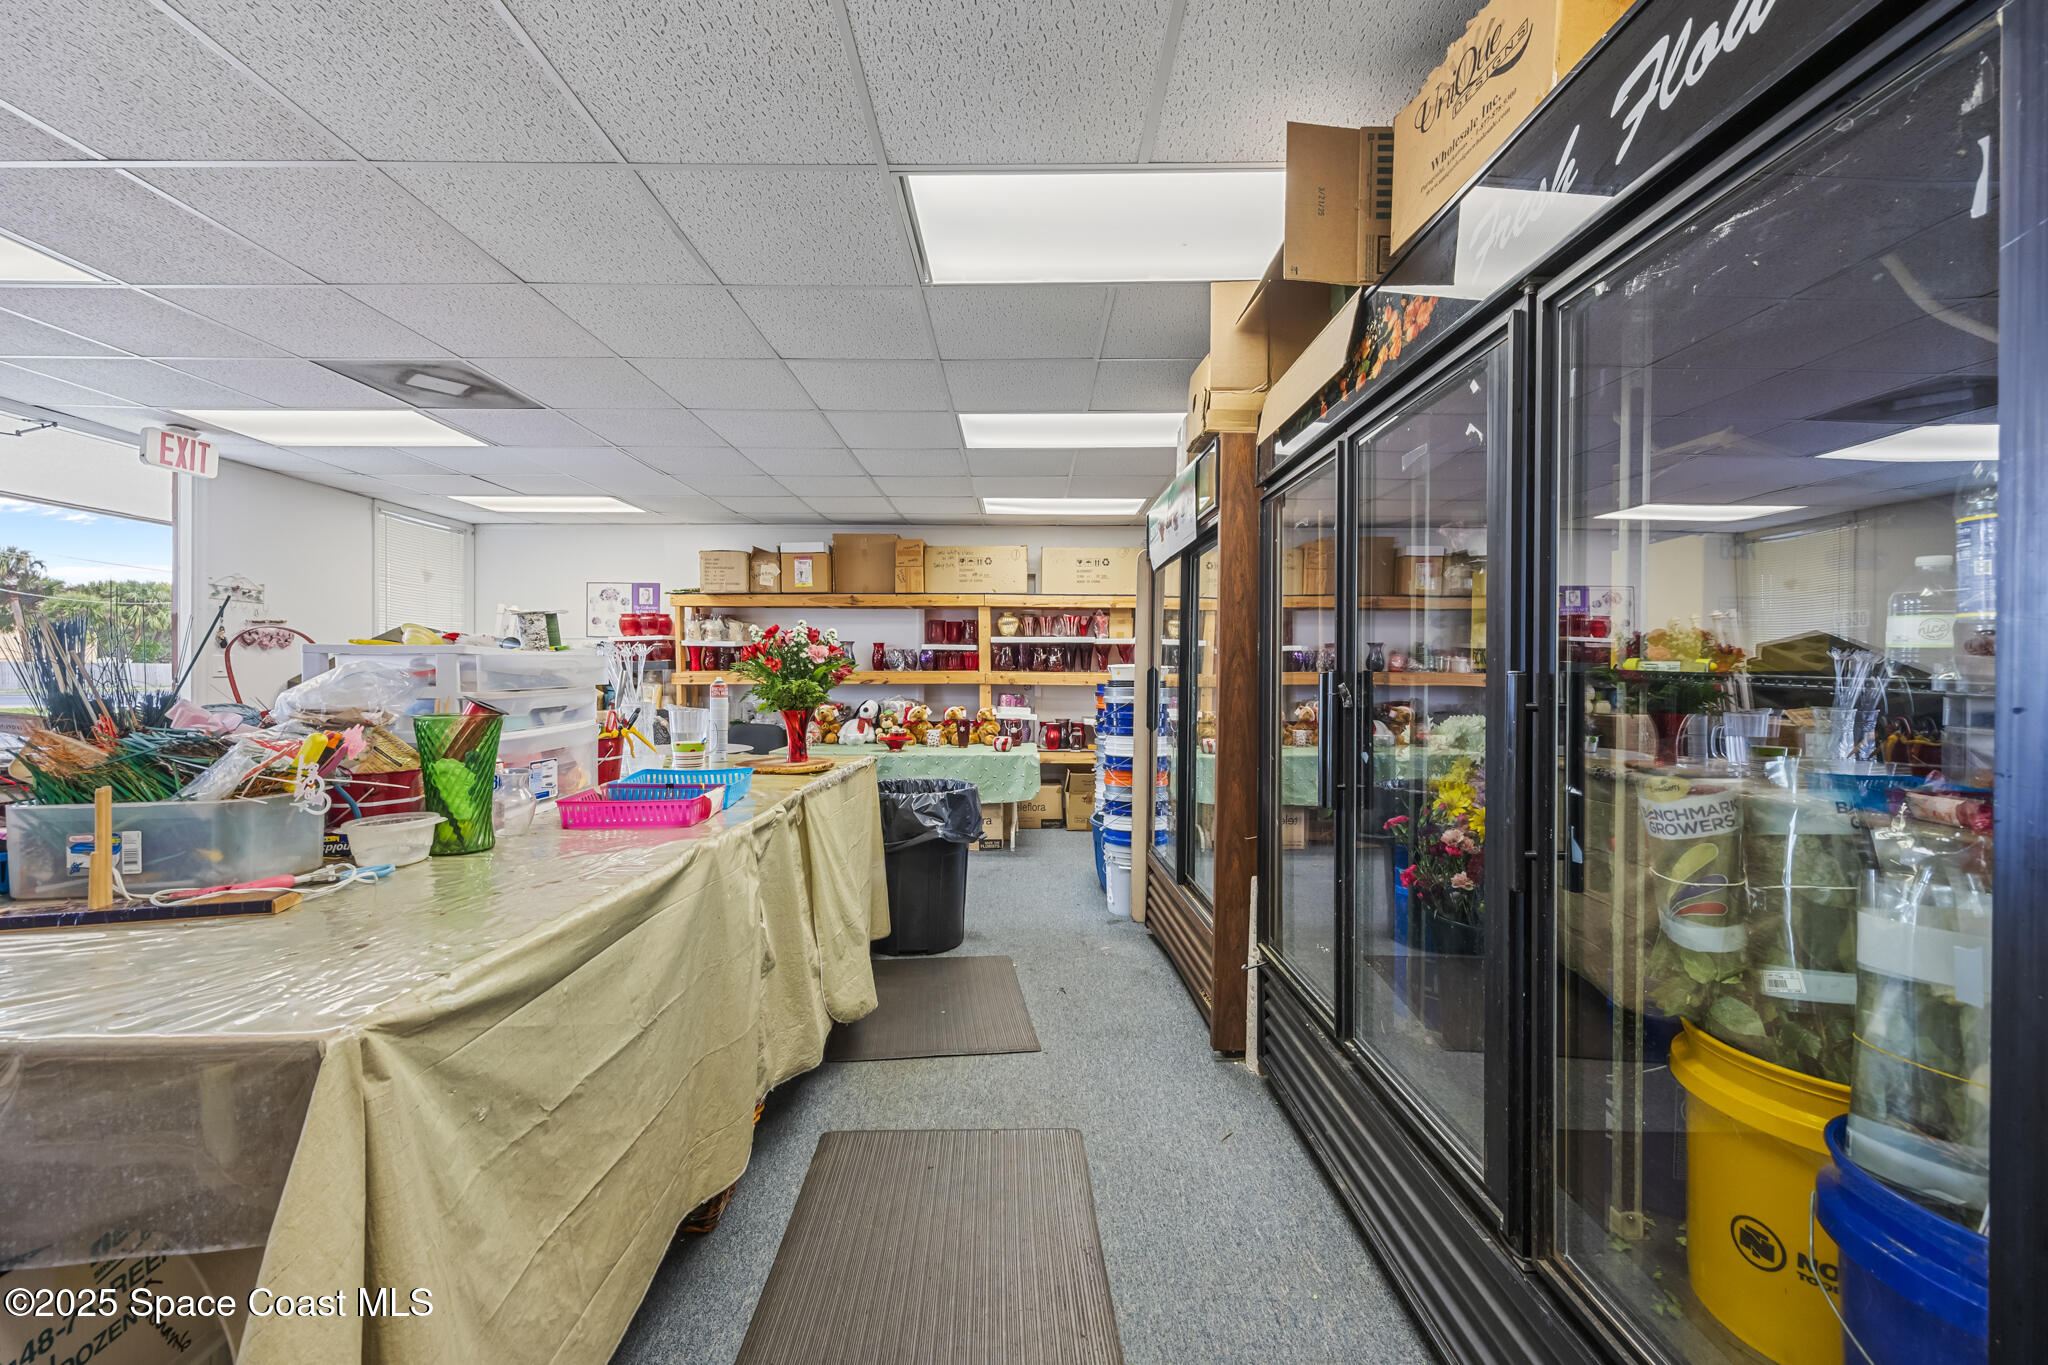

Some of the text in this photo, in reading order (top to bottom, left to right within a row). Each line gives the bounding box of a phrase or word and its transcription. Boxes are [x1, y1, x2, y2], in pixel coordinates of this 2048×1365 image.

[1452, 19, 1528, 119] DESIGNS
[1431, 116, 1479, 171] Wholesale
[1468, 124, 1580, 285] Fresh
[160, 431, 211, 474] EXIT
[1649, 815, 1736, 837] GROWERS
